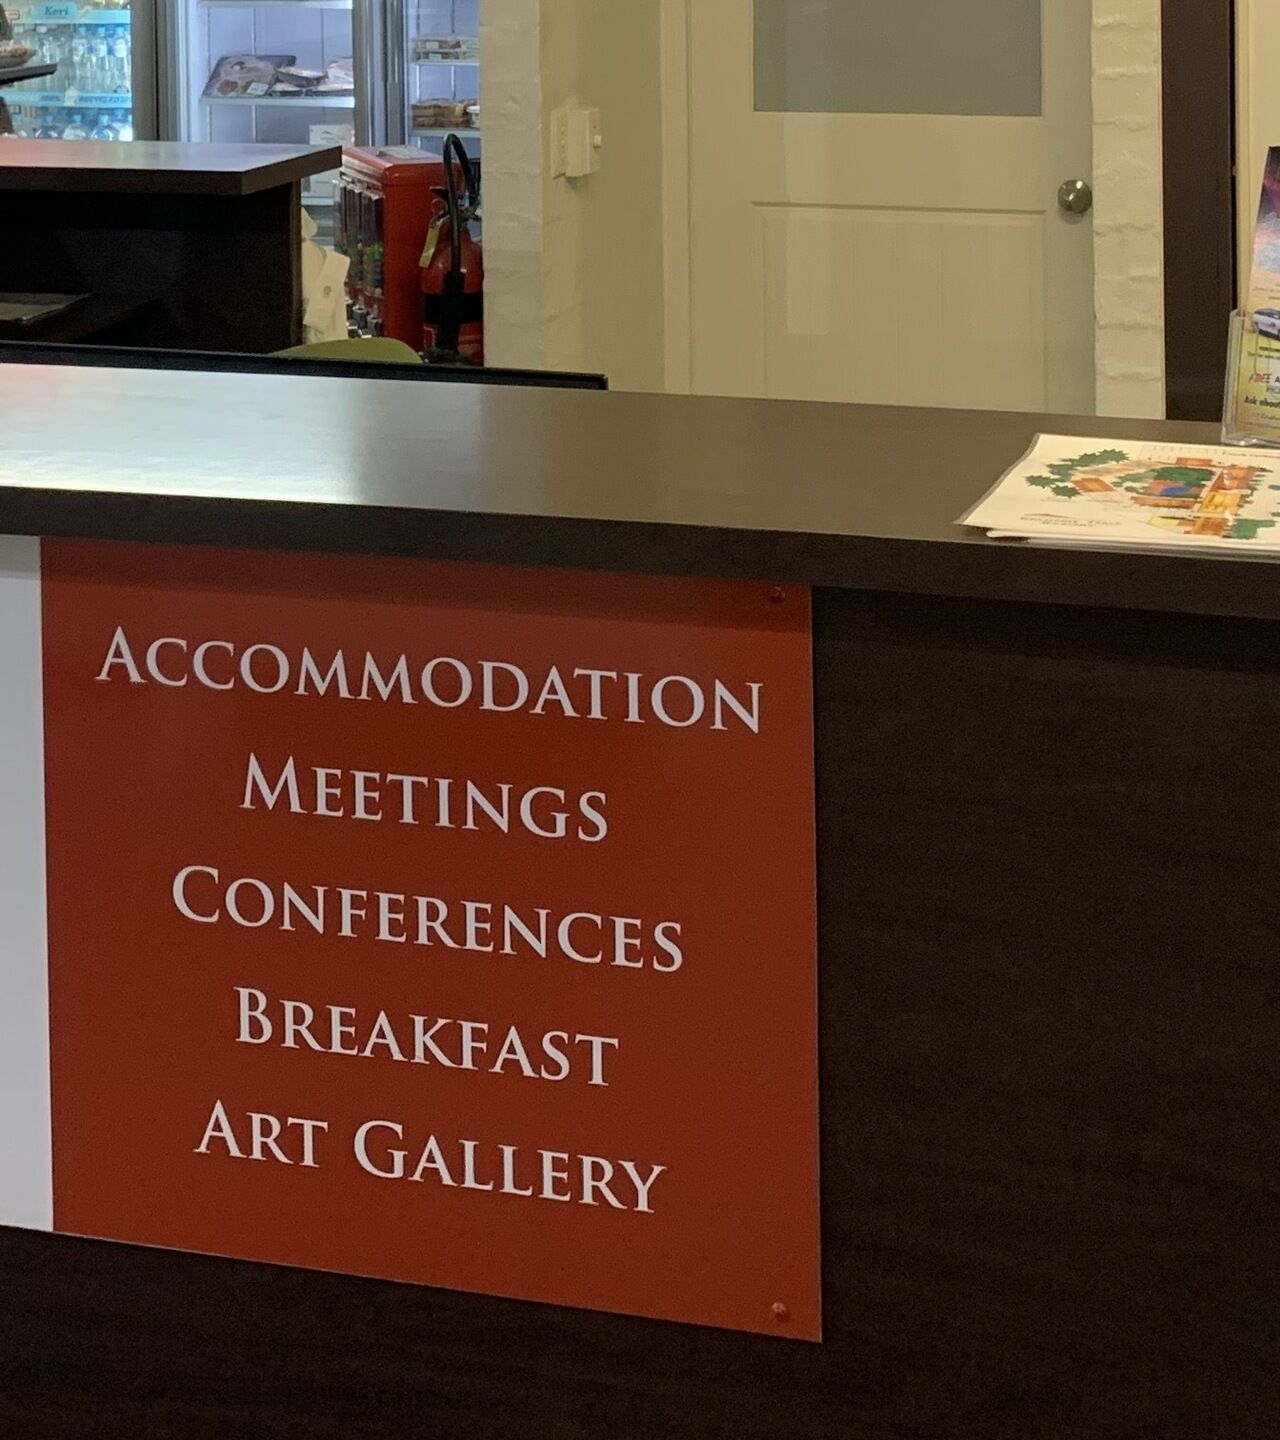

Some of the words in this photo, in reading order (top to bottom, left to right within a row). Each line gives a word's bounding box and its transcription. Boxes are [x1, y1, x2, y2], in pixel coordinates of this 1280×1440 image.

[95, 625, 763, 734] ACCOMMODATION
[239, 752, 609, 842] MEETINGS
[172, 865, 684, 972] CONFERENCES
[233, 986, 619, 1086] BREAKFAST
[193, 1099, 329, 1168] ART
[354, 1120, 667, 1215] GALLERY
